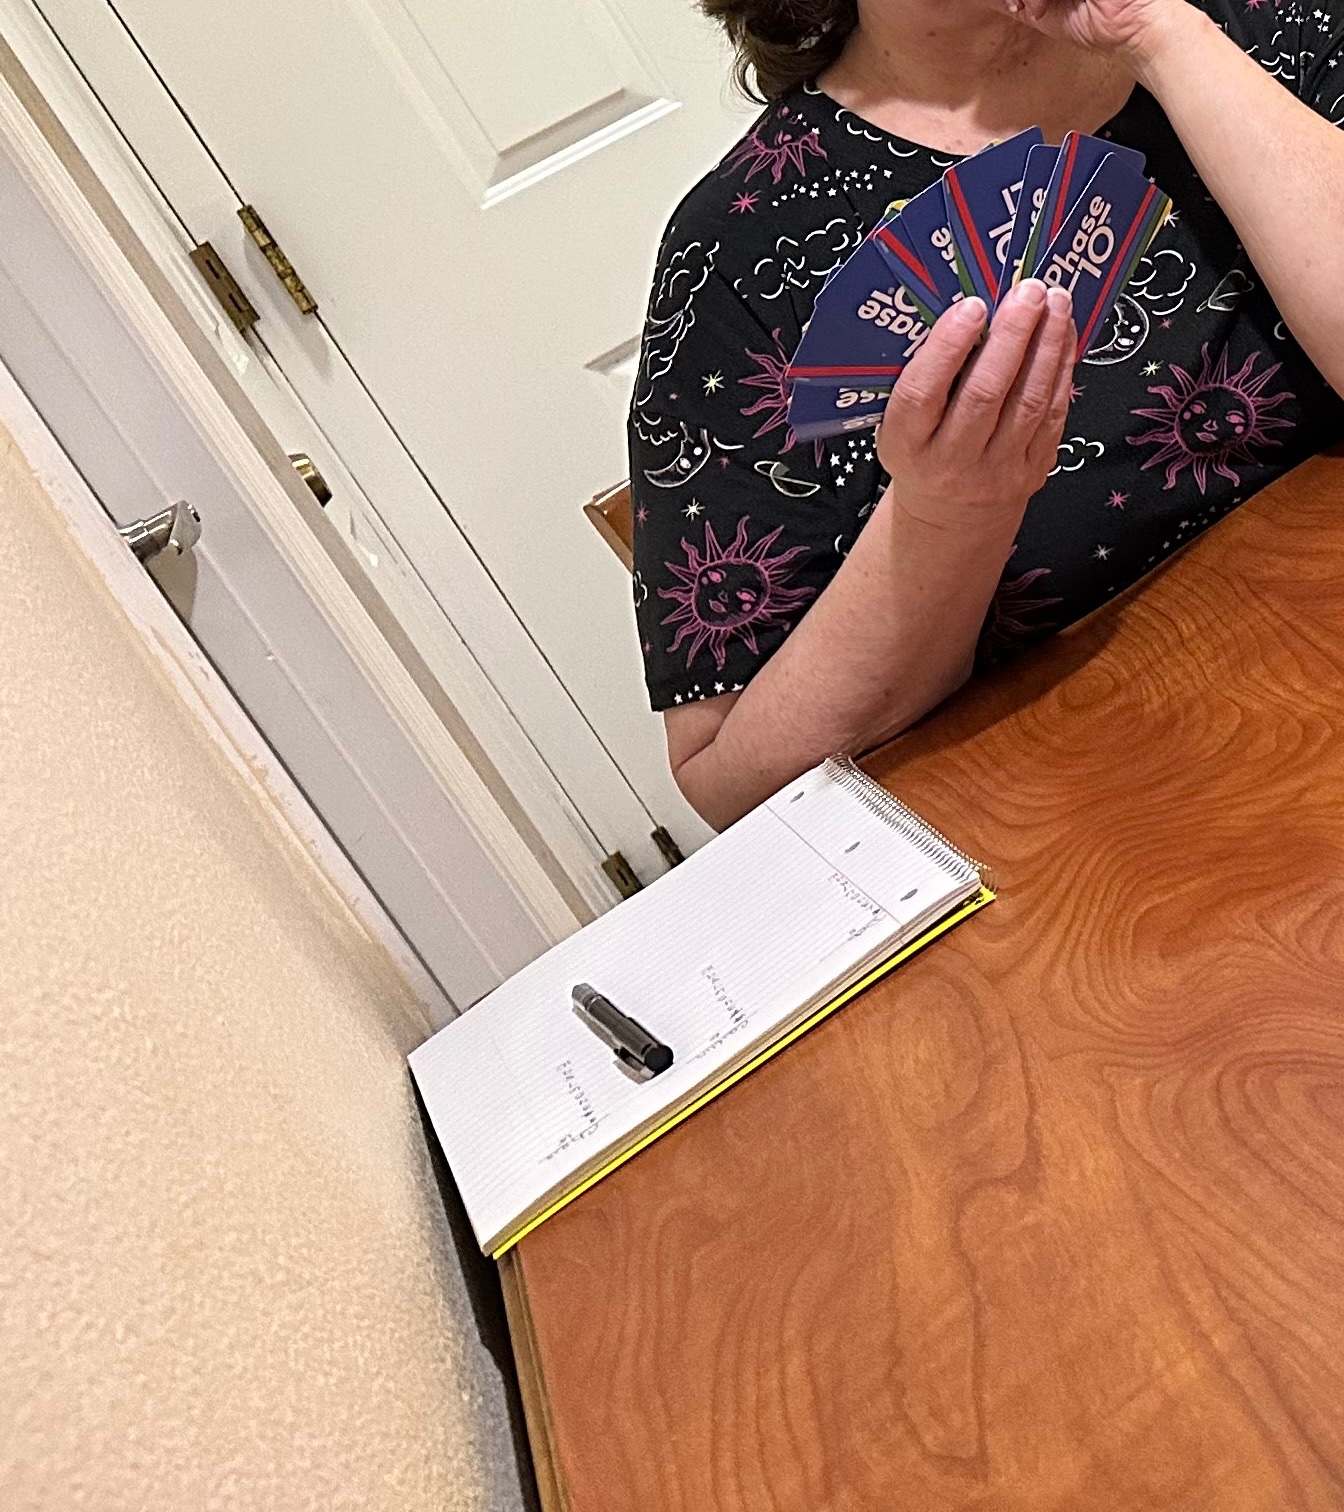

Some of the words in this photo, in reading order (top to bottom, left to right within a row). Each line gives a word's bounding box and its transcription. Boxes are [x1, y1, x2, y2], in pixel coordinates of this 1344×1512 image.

[1043, 194, 1105, 289] Phase
[1078, 223, 1116, 280] 10
[857, 298, 933, 358] hase
